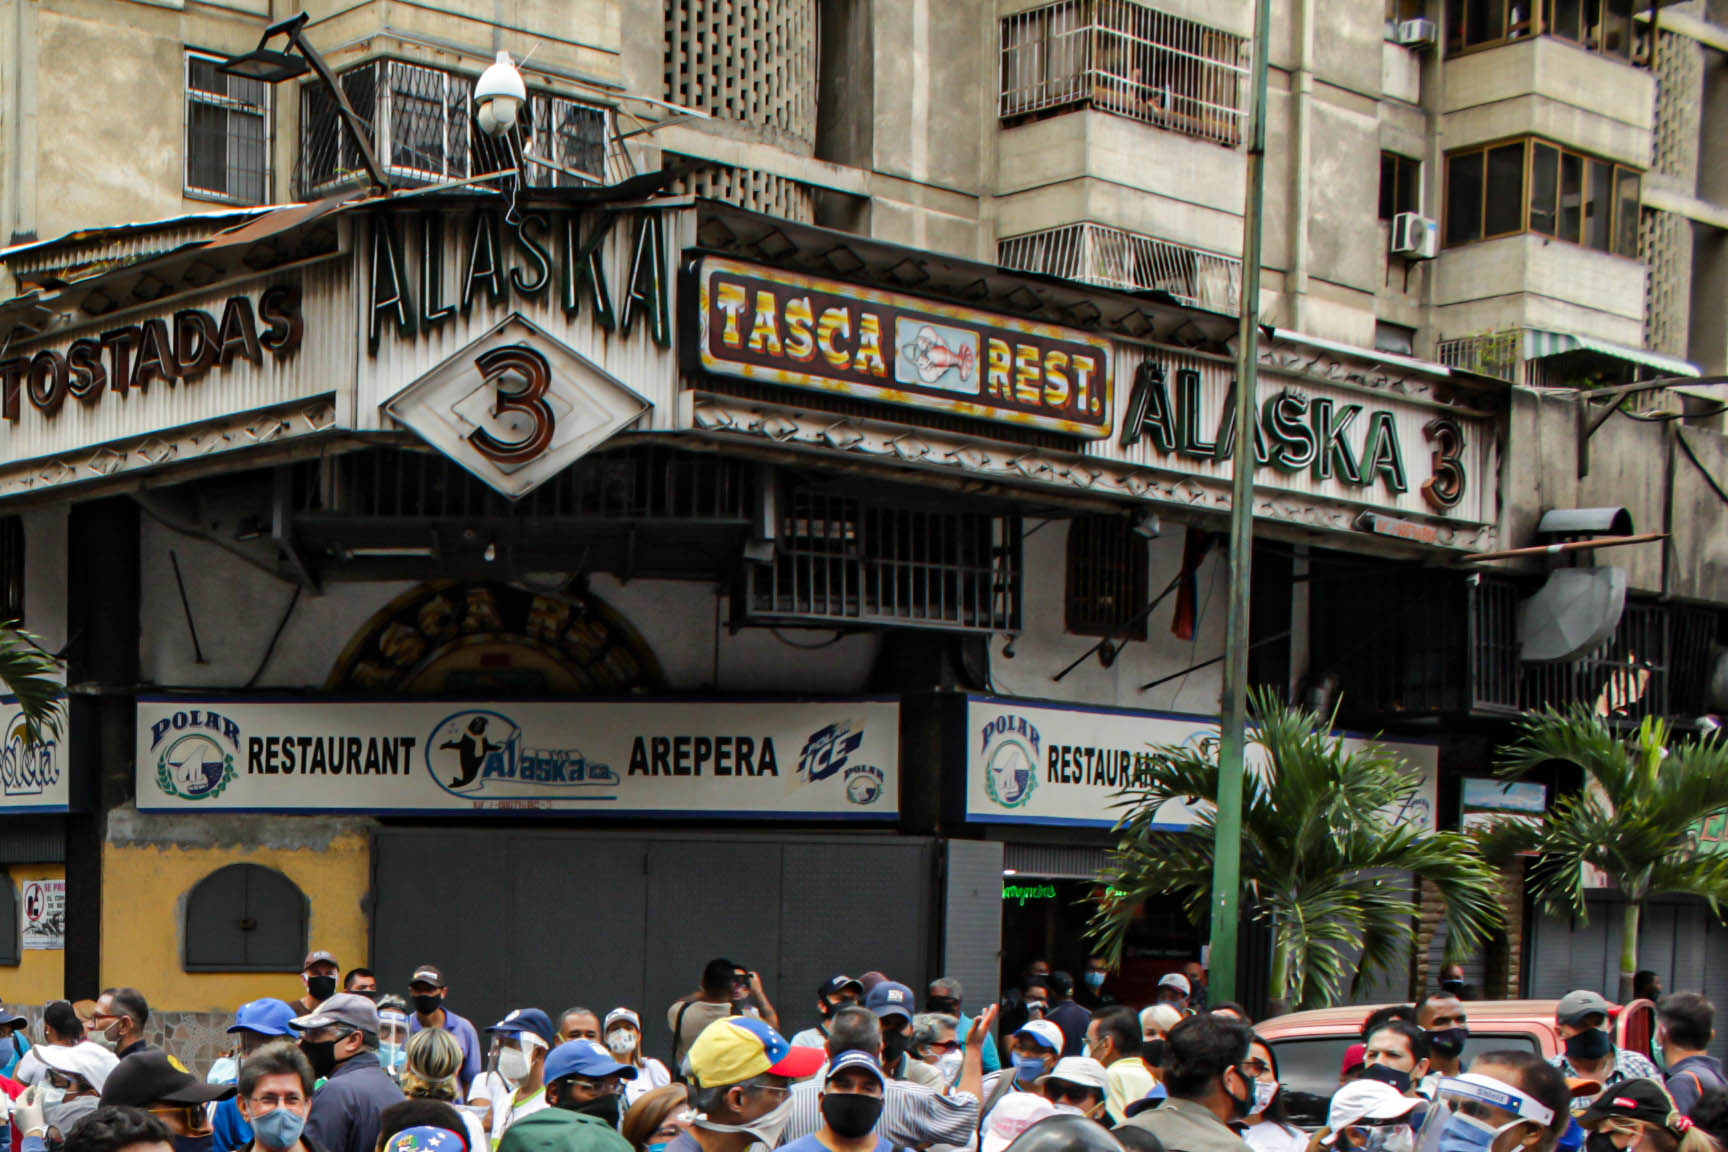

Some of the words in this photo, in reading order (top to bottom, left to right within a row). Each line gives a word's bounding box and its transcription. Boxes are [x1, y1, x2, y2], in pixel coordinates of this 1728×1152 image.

[369, 211, 671, 358] ALASKA
[716, 281, 888, 379] TASCA
[988, 335, 1101, 412] REST.
[467, 344, 556, 465] 3
[1122, 360, 1409, 495] ALASKA
[1421, 416, 1467, 509] 3
[151, 710, 241, 751] POLAR
[981, 714, 1041, 758] POLAR
[247, 736, 417, 776] RESTAURANT
[481, 737, 586, 783] Alaska
[627, 736, 779, 778] AREPERA
